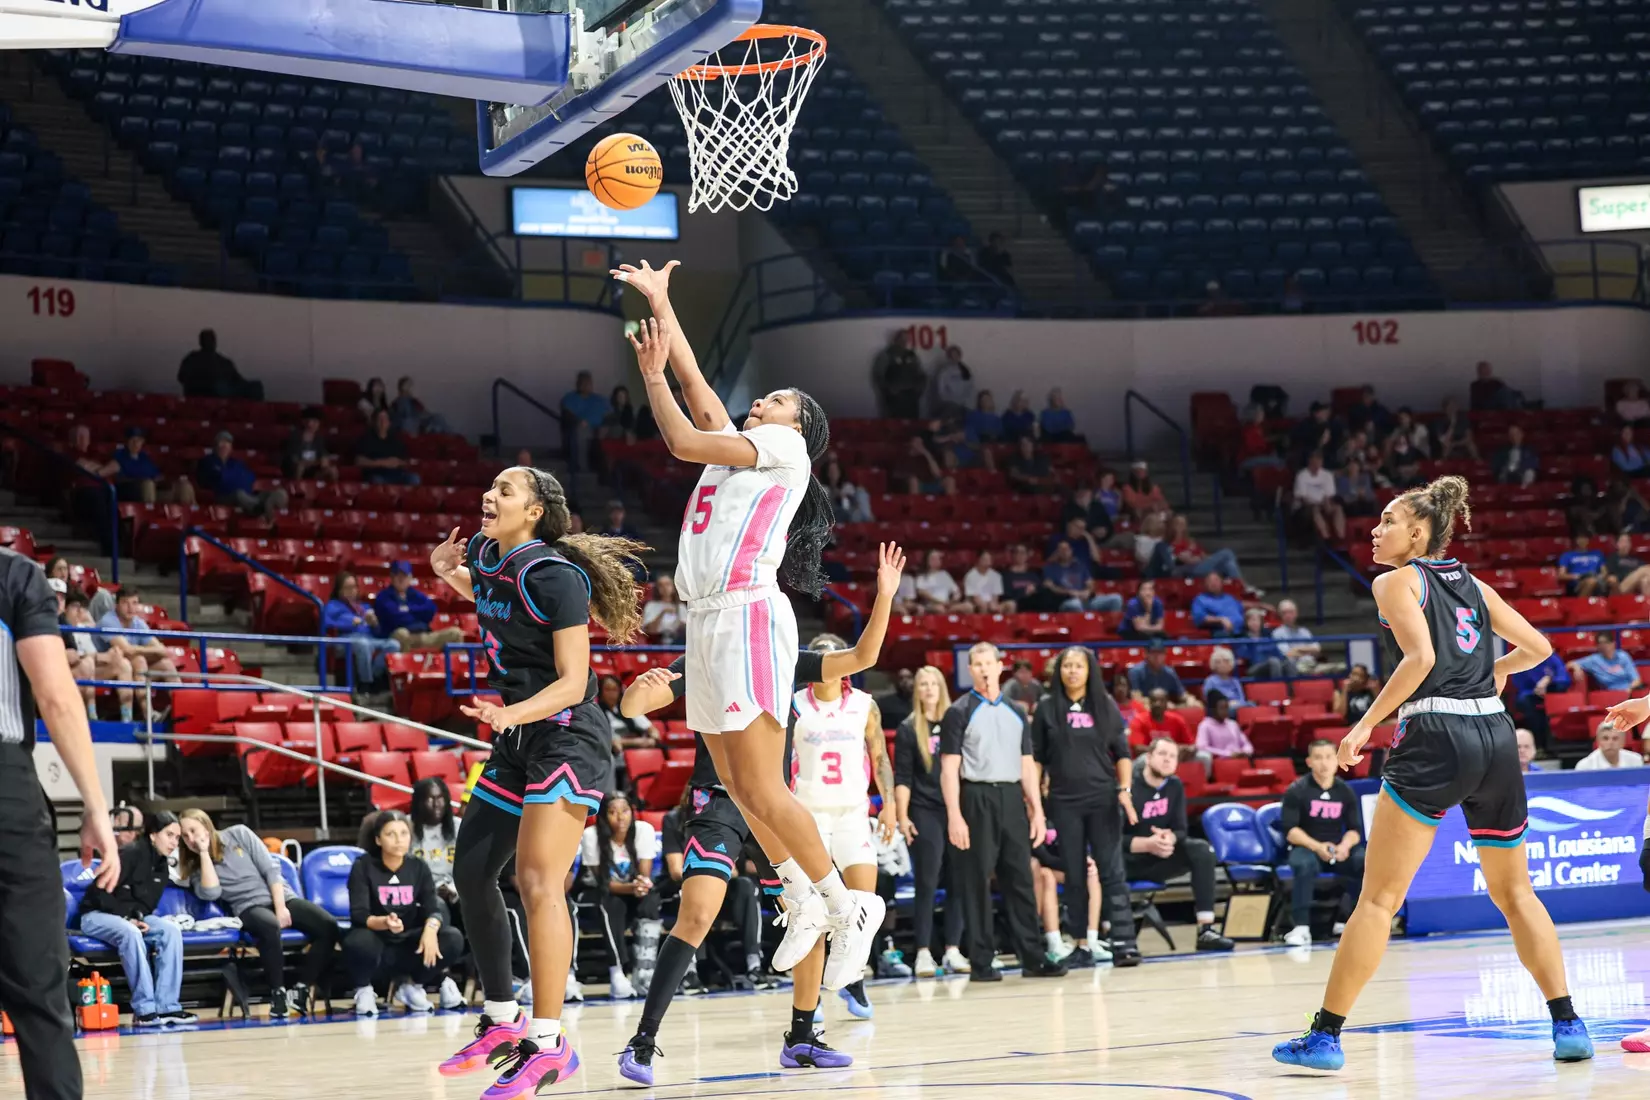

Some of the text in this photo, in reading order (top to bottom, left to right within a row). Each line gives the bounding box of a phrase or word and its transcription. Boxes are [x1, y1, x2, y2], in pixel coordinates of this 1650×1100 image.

[26, 285, 76, 317] 119
[907, 324, 948, 351] 101
[1351, 319, 1400, 346] 102
[1455, 607, 1480, 654] 5
[820, 751, 843, 785] 3
[1309, 799, 1343, 819] FIU
[1454, 830, 1637, 865] Norn Louisiana
[1554, 861, 1622, 886] Center
[378, 885, 414, 906] FIU
